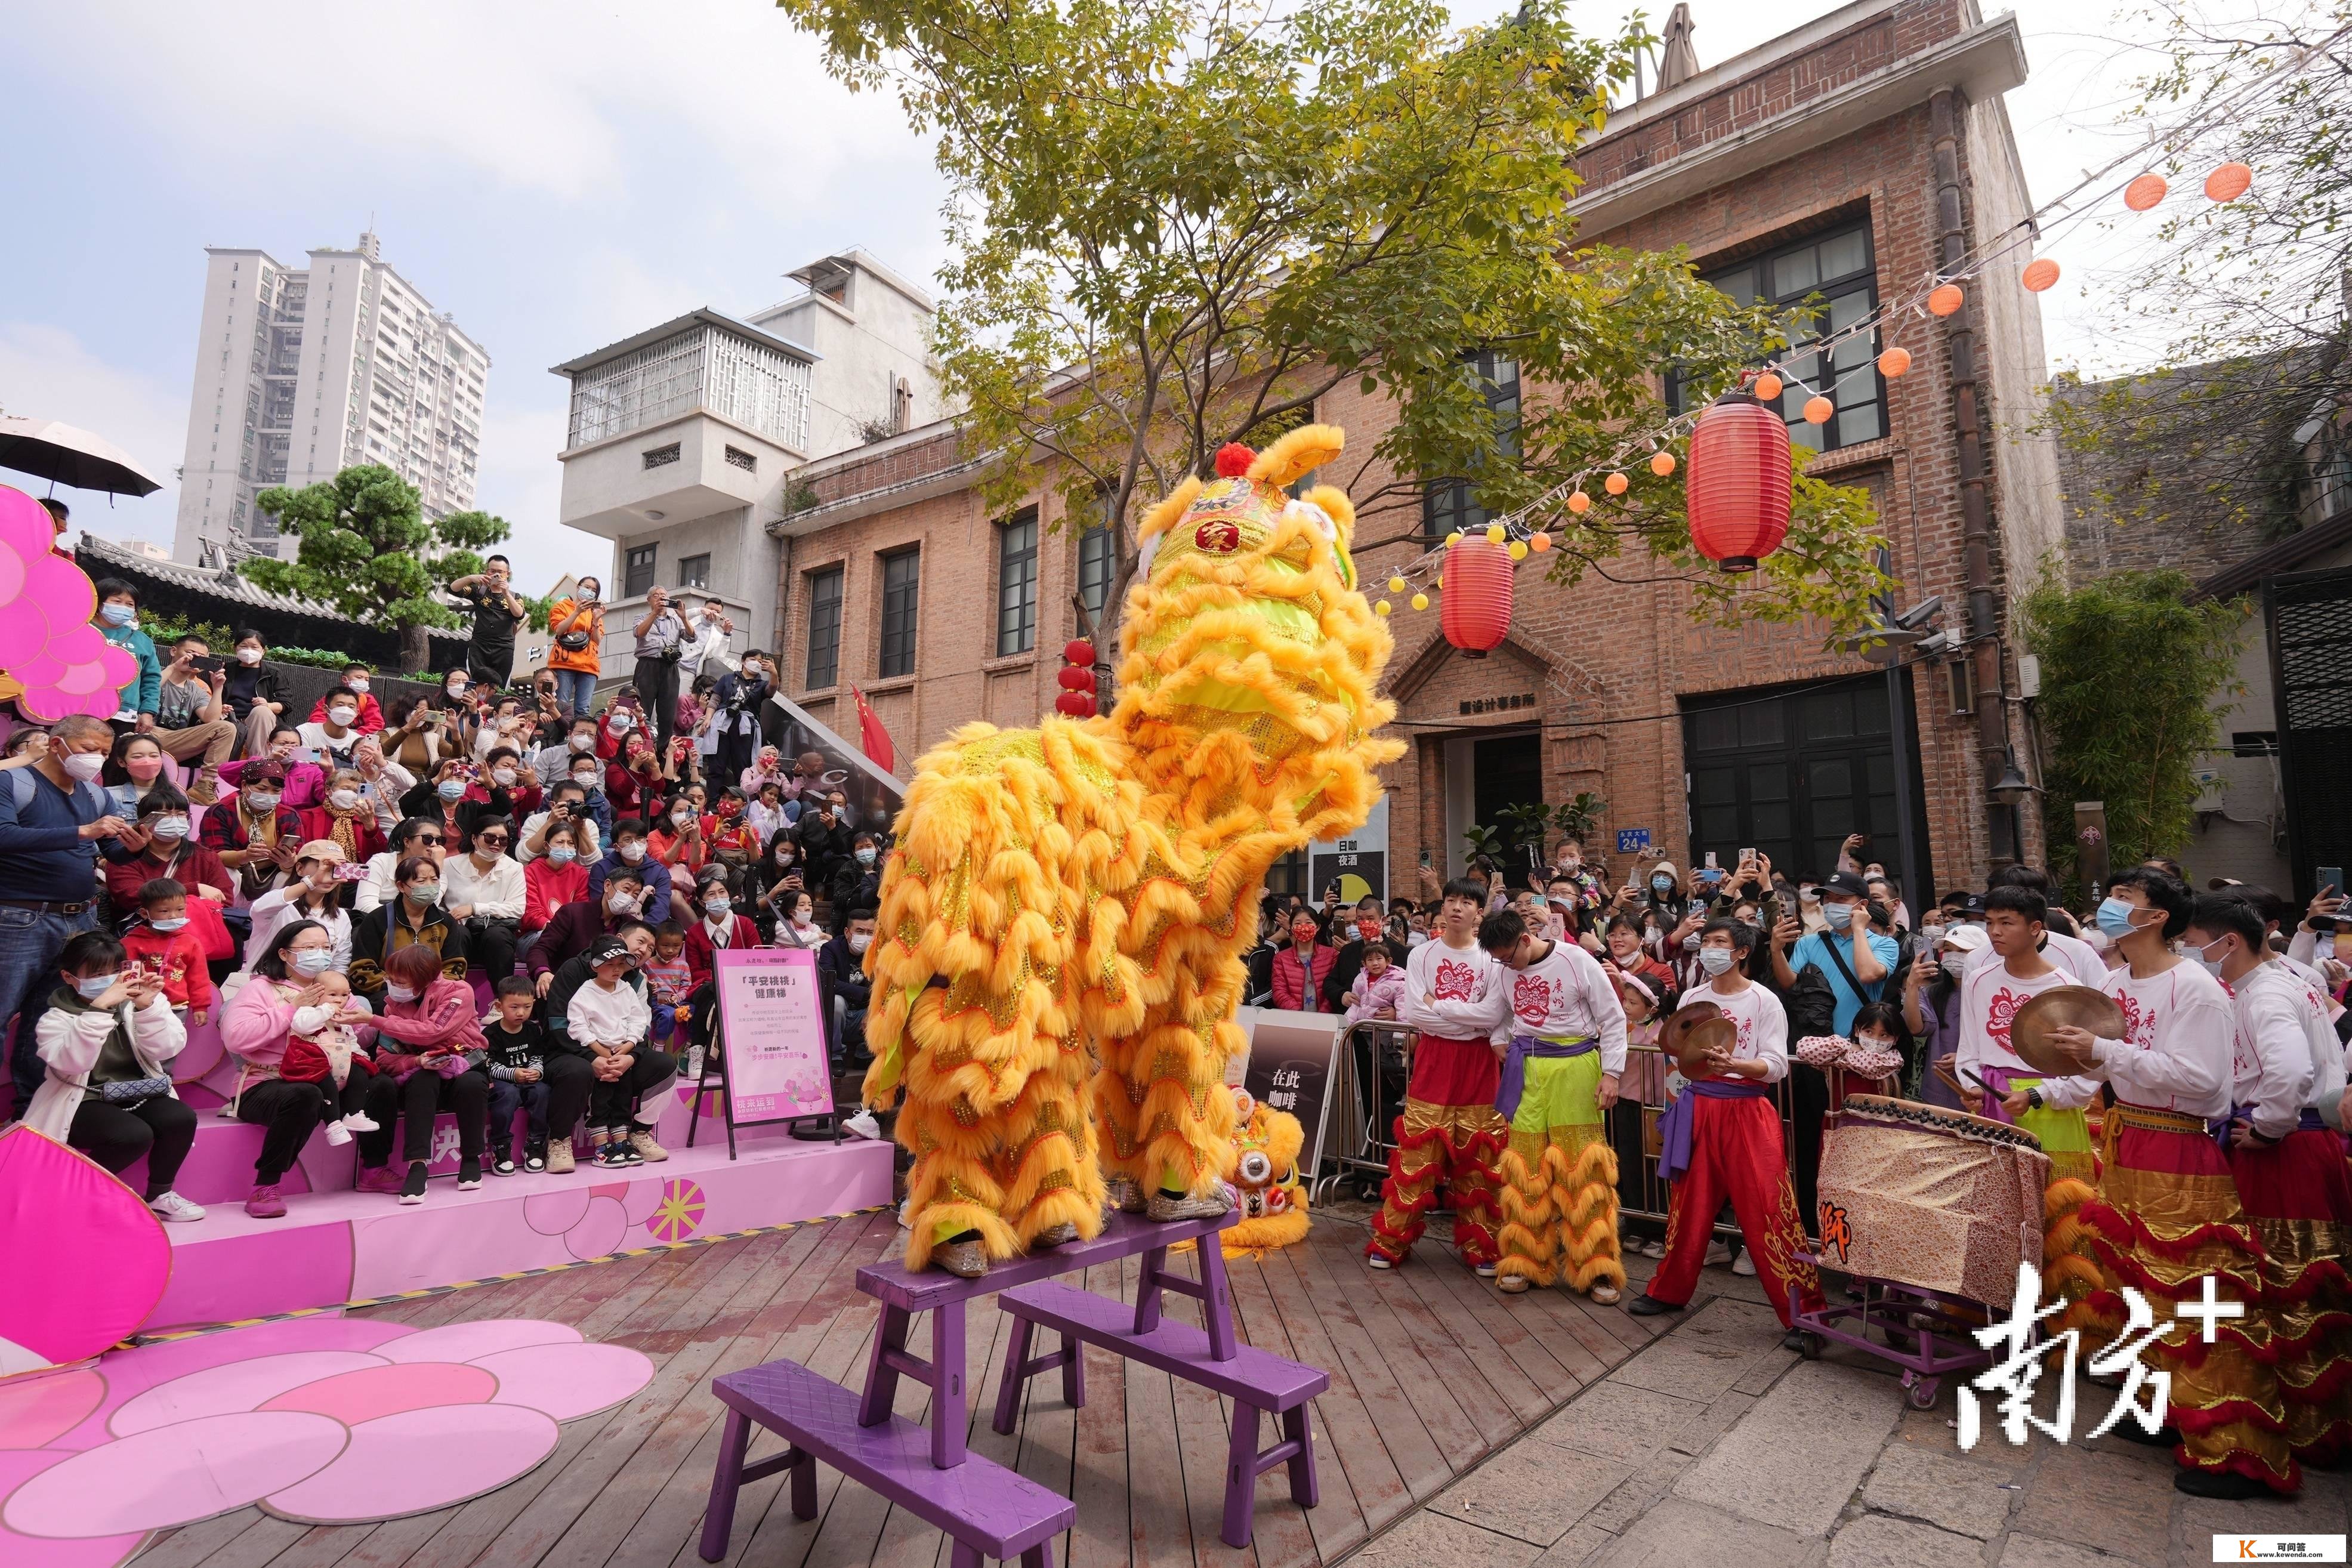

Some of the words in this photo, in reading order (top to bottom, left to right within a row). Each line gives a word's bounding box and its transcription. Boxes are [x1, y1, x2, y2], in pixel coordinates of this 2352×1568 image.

[1339, 840, 1357, 852] 日咖
[1622, 838, 1638, 850] 24
[1338, 854, 1357, 866] 夜酒
[755, 988, 786, 999] 健康梯
[1272, 1069, 1301, 1089] 在此
[736, 1097, 775, 1109] 桃来运到
[1268, 1089, 1298, 1110] 咖啡
